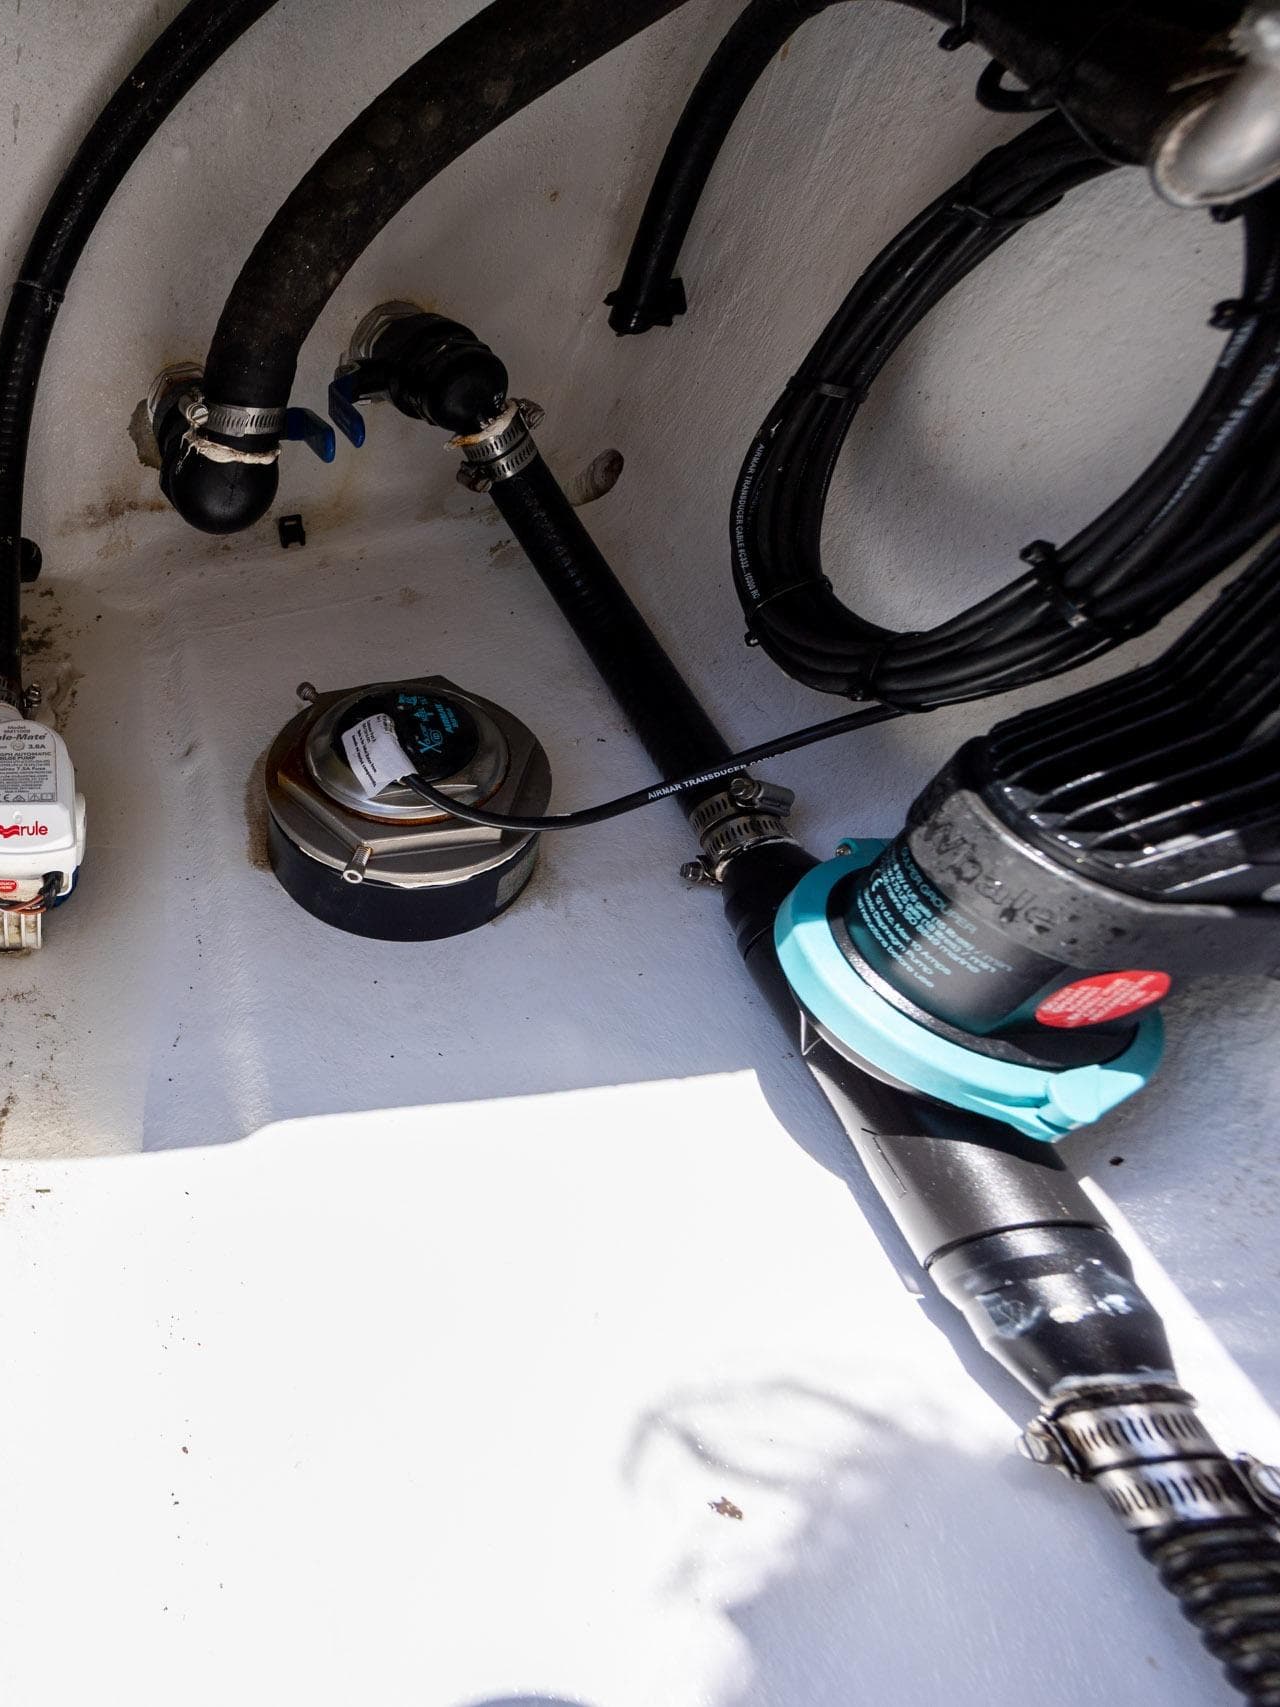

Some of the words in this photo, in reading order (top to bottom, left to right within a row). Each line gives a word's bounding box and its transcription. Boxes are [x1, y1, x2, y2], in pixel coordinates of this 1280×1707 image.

[748, 443, 765, 474] AIRMAR
[736, 476, 752, 525] TRANSDUCER
[736, 526, 744, 548] CABLE
[648, 783, 682, 800] AIRMAR
[684, 764, 747, 788] TRANSDUCER
[20, 820, 48, 836] rule
[887, 946, 913, 973] before
[914, 972, 934, 988] use
[905, 951, 932, 975] Pump
[920, 951, 950, 975] Amps
